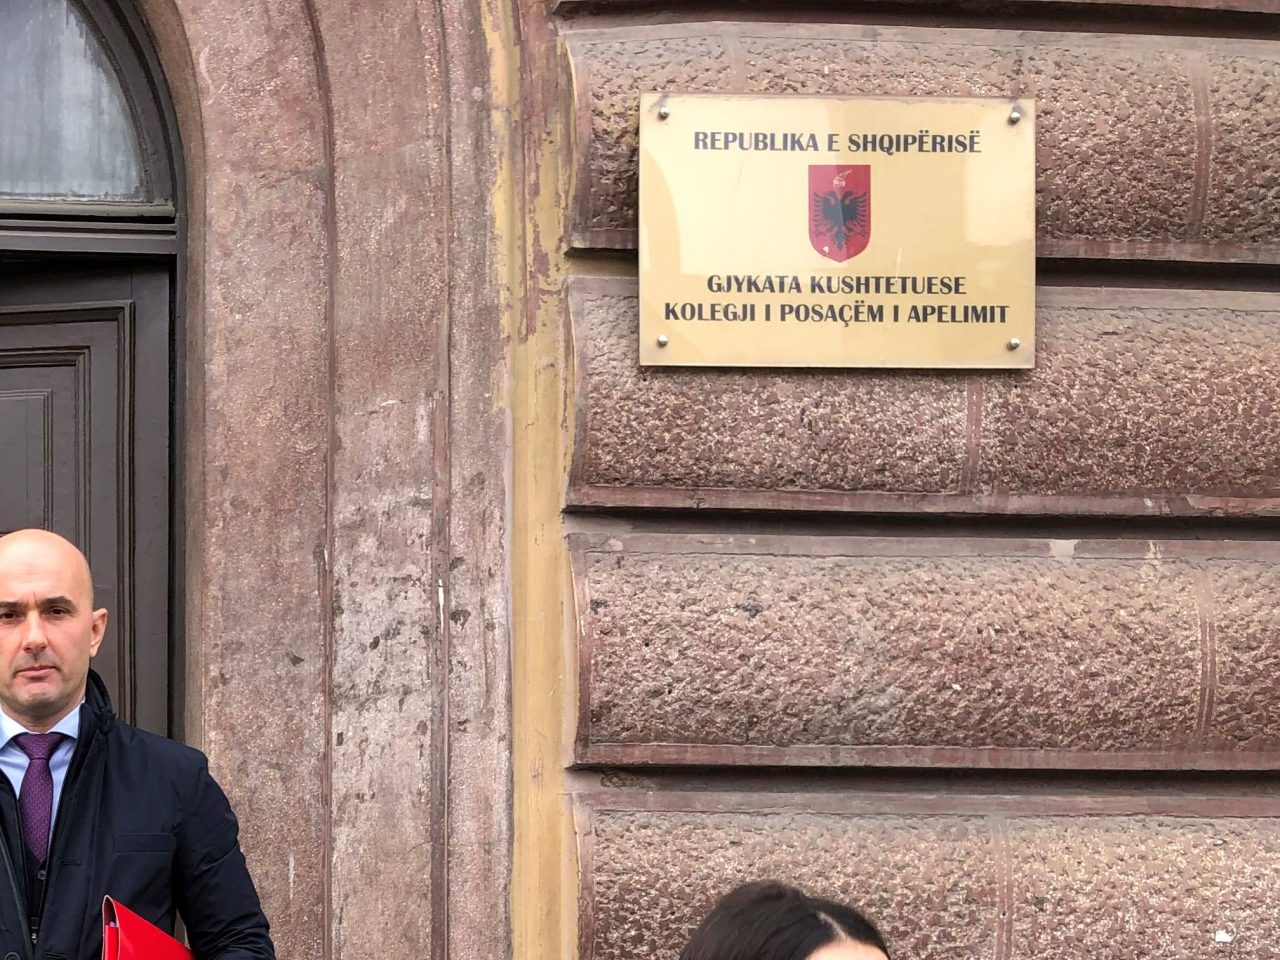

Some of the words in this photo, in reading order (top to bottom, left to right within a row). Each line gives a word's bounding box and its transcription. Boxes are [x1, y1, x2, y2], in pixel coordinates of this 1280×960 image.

[693, 131, 819, 152] REPUBLIKA
[827, 133, 840, 152] E
[847, 129, 982, 156] SHQIPËRISË
[707, 274, 802, 294] GJYKATA
[810, 275, 967, 295] KUSHTETUESE
[664, 302, 756, 322] KOLEGJI
[764, 303, 772, 322] I
[780, 299, 885, 328] POSAÇËM
[892, 304, 900, 323] I
[906, 304, 1011, 324] APELIMIT
